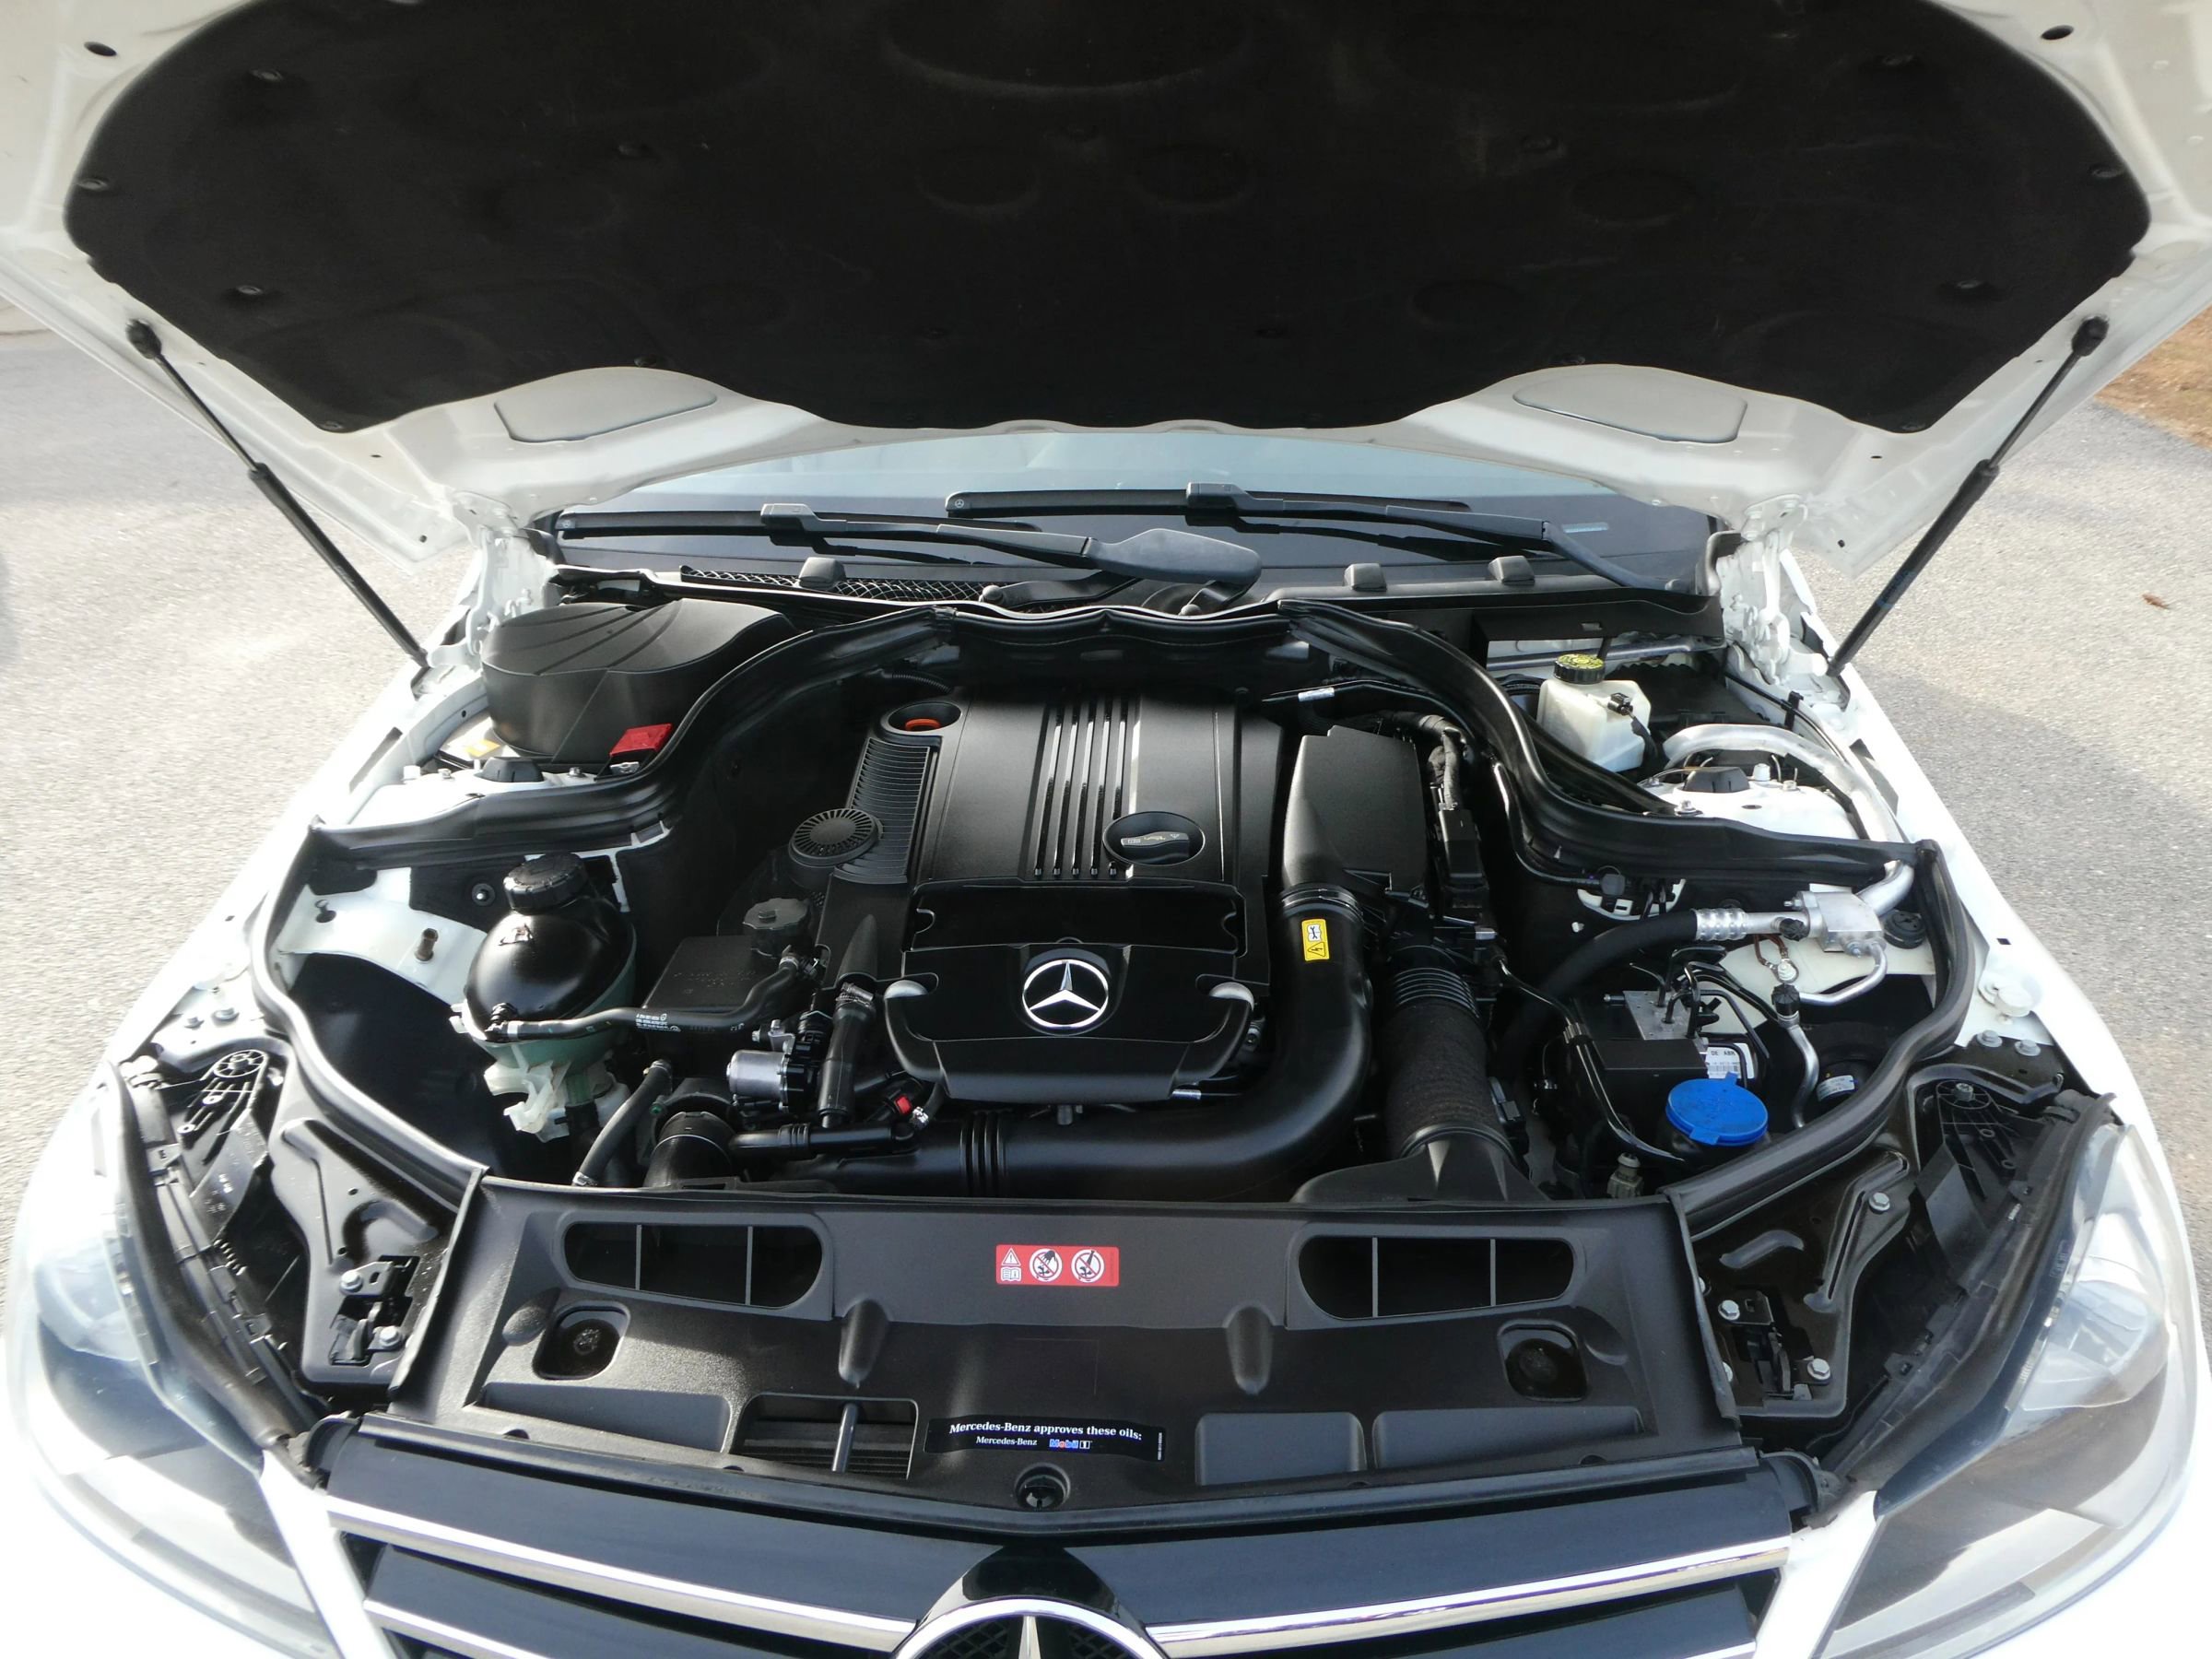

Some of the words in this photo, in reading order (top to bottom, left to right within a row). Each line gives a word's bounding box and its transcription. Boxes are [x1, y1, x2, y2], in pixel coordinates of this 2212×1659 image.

[949, 1421, 1031, 1433] Mercedes-Benz
[1033, 1425, 1084, 1435] approves
[1087, 1426, 1117, 1436] these
[1119, 1428, 1143, 1441] oils:
[976, 1436, 1038, 1446] Mercedes-Benz
[1049, 1439, 1079, 1449] Mobil
